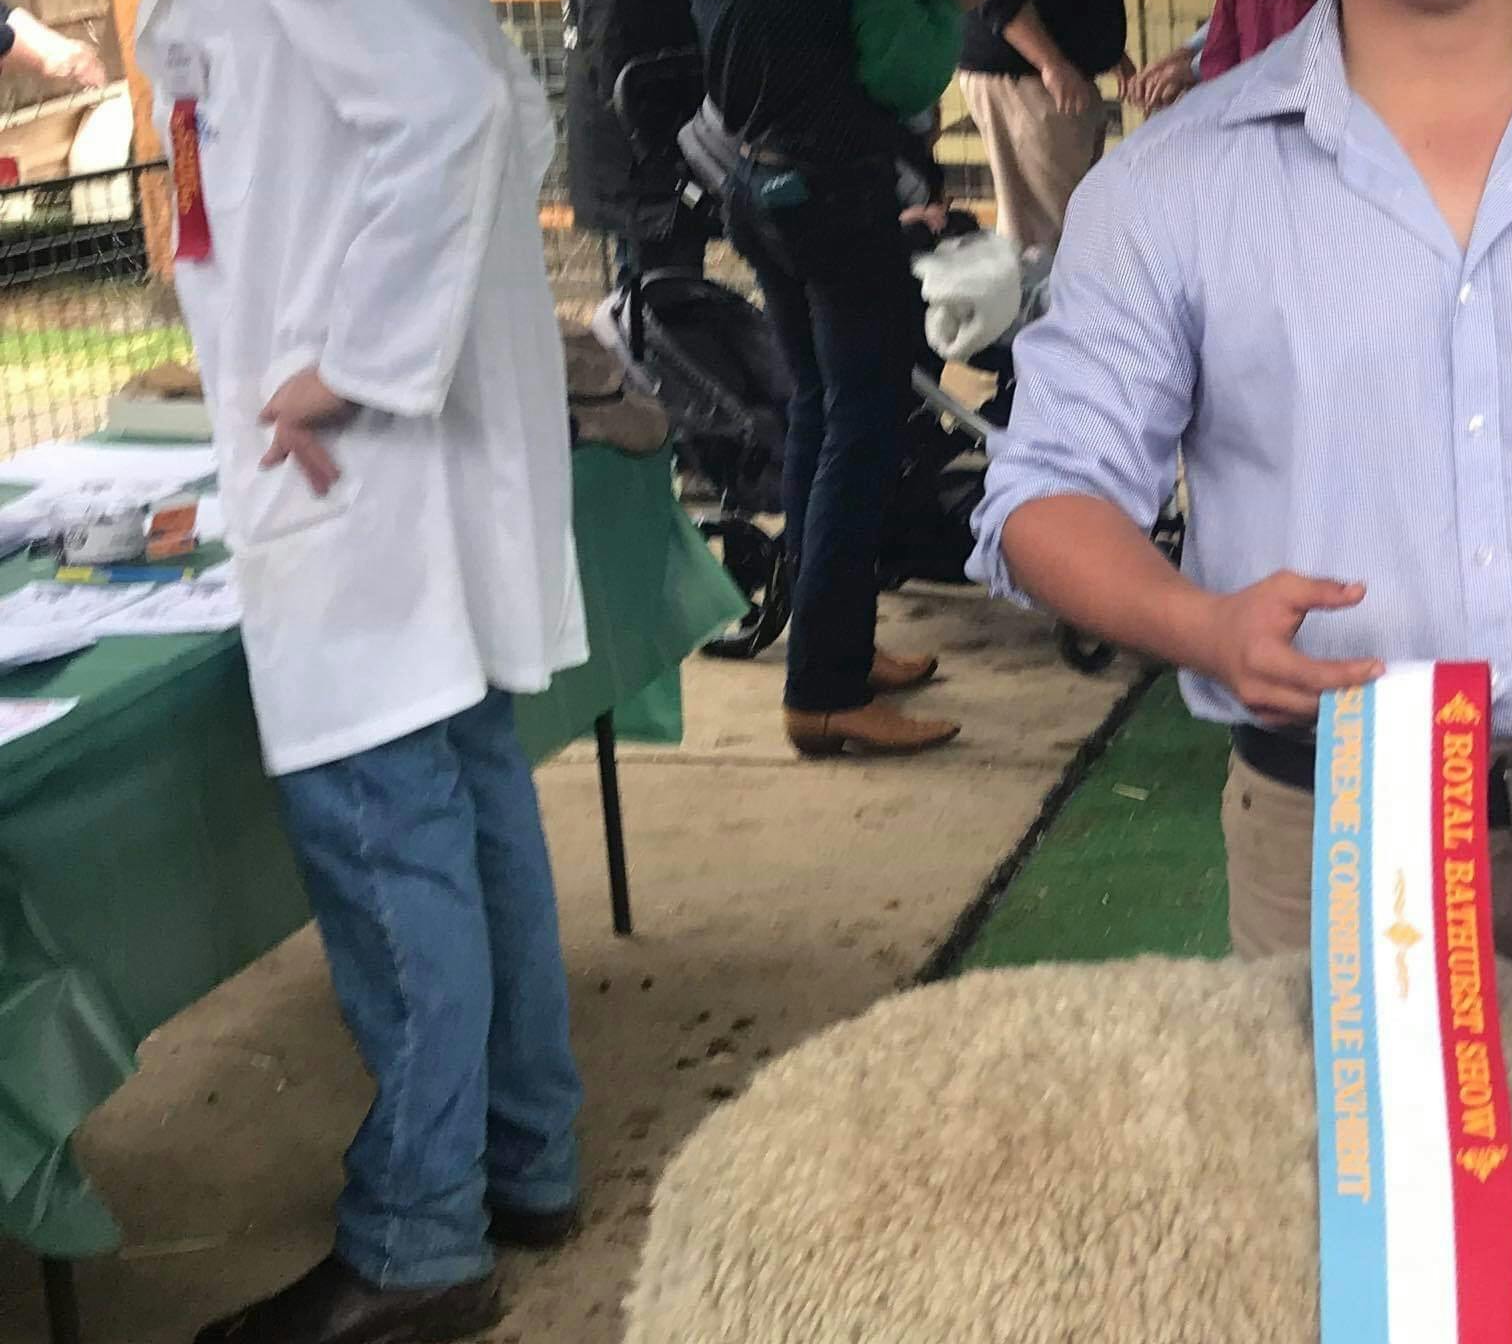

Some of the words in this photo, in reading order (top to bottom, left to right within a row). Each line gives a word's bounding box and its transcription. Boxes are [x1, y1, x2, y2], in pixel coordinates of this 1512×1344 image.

[1330, 685, 1363, 835] SUPREME
[1443, 730, 1475, 849] ROYAL
[1328, 840, 1364, 1053] CORRIEDALE
[1444, 857, 1485, 1034] BATHURST
[1333, 1058, 1371, 1204] EXHIBIT
[1455, 1040, 1497, 1140] SHOW
